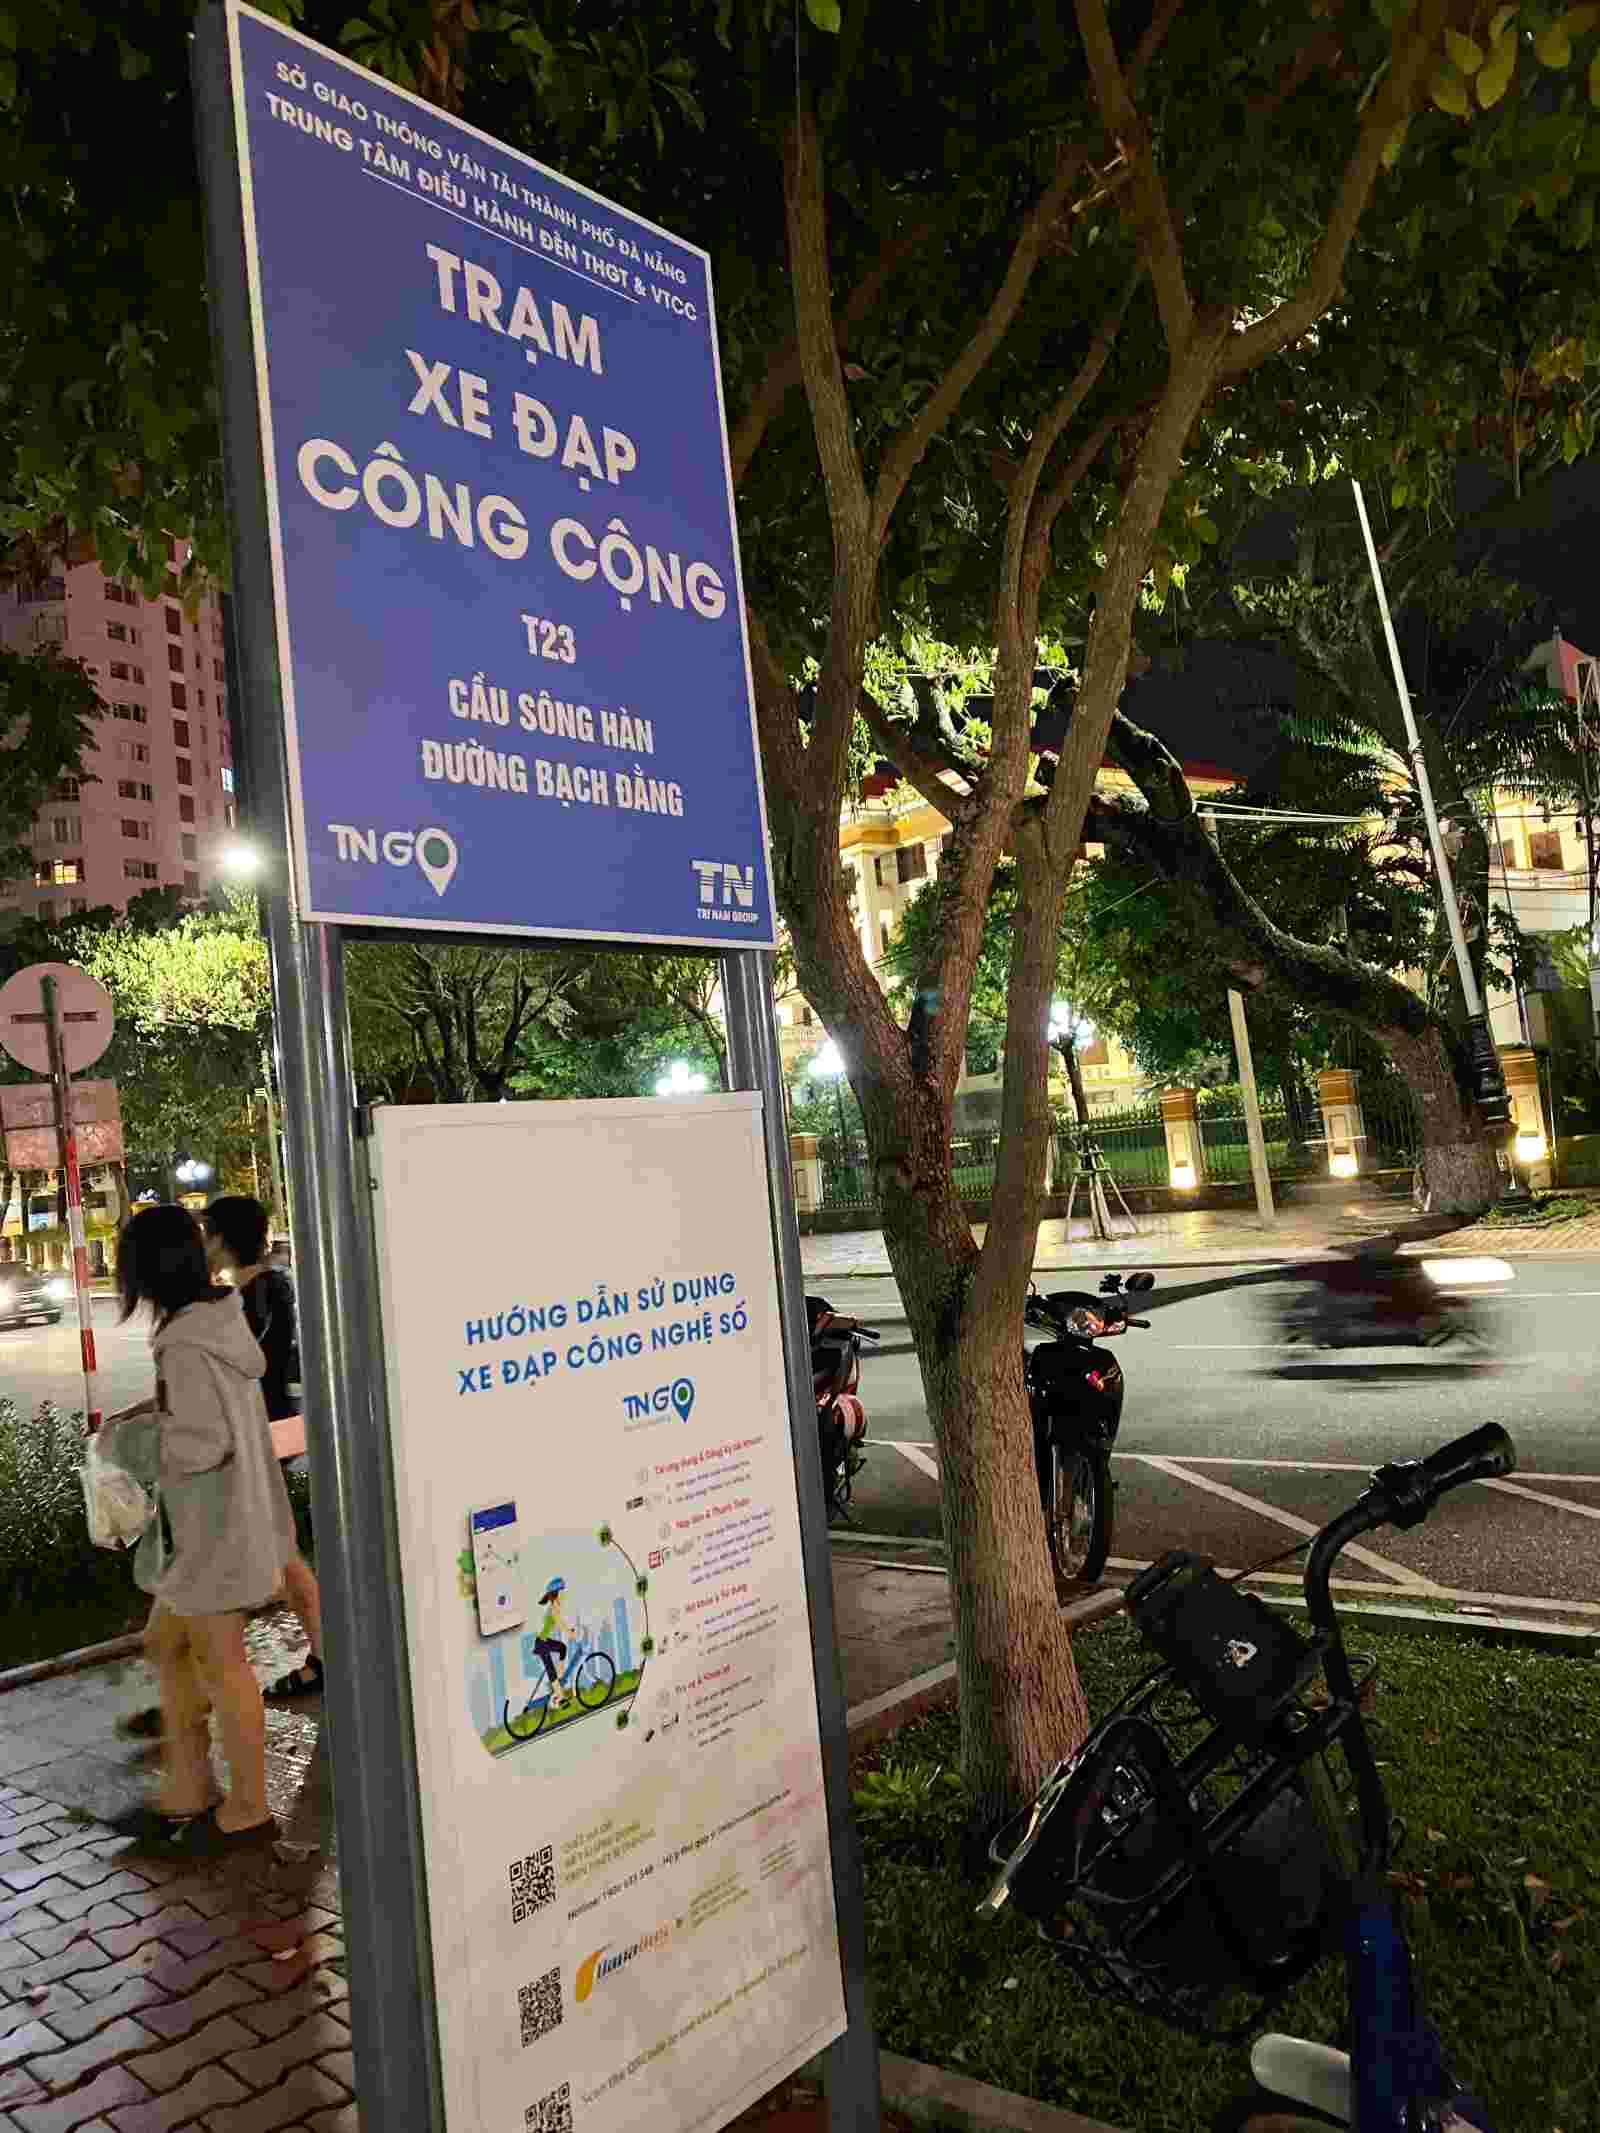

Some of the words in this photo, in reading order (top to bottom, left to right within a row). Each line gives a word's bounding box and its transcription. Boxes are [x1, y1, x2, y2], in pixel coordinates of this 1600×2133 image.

[266, 92, 353, 152] TRUNG
[360, 138, 410, 183] TÂM
[417, 164, 466, 209] ĐIỀU
[474, 197, 534, 243] HÀNH
[539, 228, 577, 263] ĐÈN
[582, 249, 629, 289] THGT
[633, 277, 647, 295] &
[651, 284, 697, 322] VTCC
[426, 243, 603, 375] TRẠM
[406, 349, 491, 439] XE
[513, 392, 637, 491] ĐẠP
[297, 438, 528, 560] CÔNG
[551, 518, 726, 619] CỘNG
[521, 613, 576, 664] T23
[448, 672, 510, 725] CẦU
[518, 691, 594, 742] SÔNG
[600, 707, 655, 753] HÀN
[422, 738, 527, 793] ĐƯỜNG
[536, 759, 608, 807] BẠCH
[615, 763, 683, 816] ĐẰNG
[458, 1363, 491, 1395] XE
[502, 1351, 557, 1387] ĐẠP
[567, 1333, 641, 1370] CÔNG
[651, 1313, 713, 1352] NGHỆ
[720, 1301, 748, 1337] SỐ
[466, 1304, 567, 1346] HƯỚNG
[577, 1284, 629, 1324] DẪN
[638, 1277, 666, 1312] SỬ
[673, 1272, 735, 1308] DỤNG
